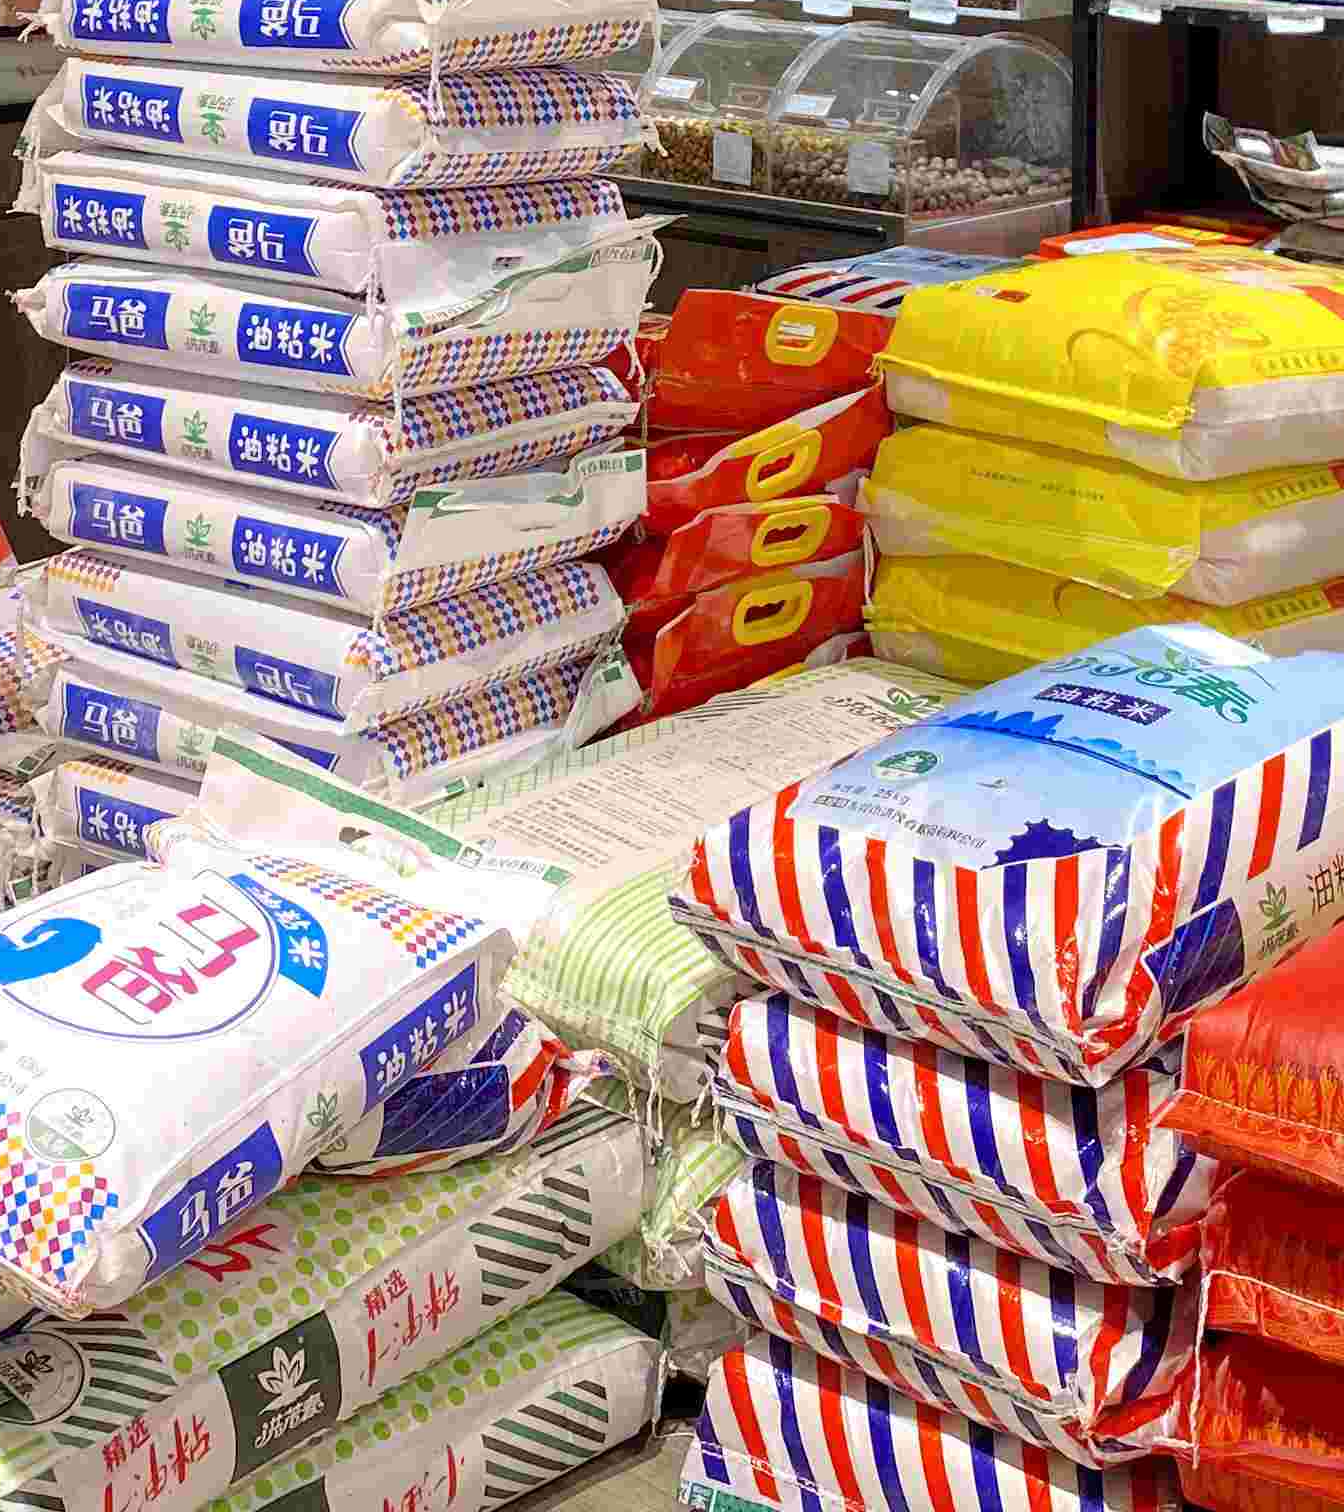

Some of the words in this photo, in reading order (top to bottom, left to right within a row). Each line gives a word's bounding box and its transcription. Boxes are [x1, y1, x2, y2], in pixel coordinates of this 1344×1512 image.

[89, 86, 173, 133] 油粘米
[57, 196, 137, 239] 油粘米
[244, 315, 338, 365] 油粘米
[234, 428, 323, 477] 油粘米
[236, 530, 330, 585] 油粘米
[377, 989, 468, 1093] 油粘米
[361, 1267, 409, 1321] 精选
[101, 1414, 153, 1473] 精选
